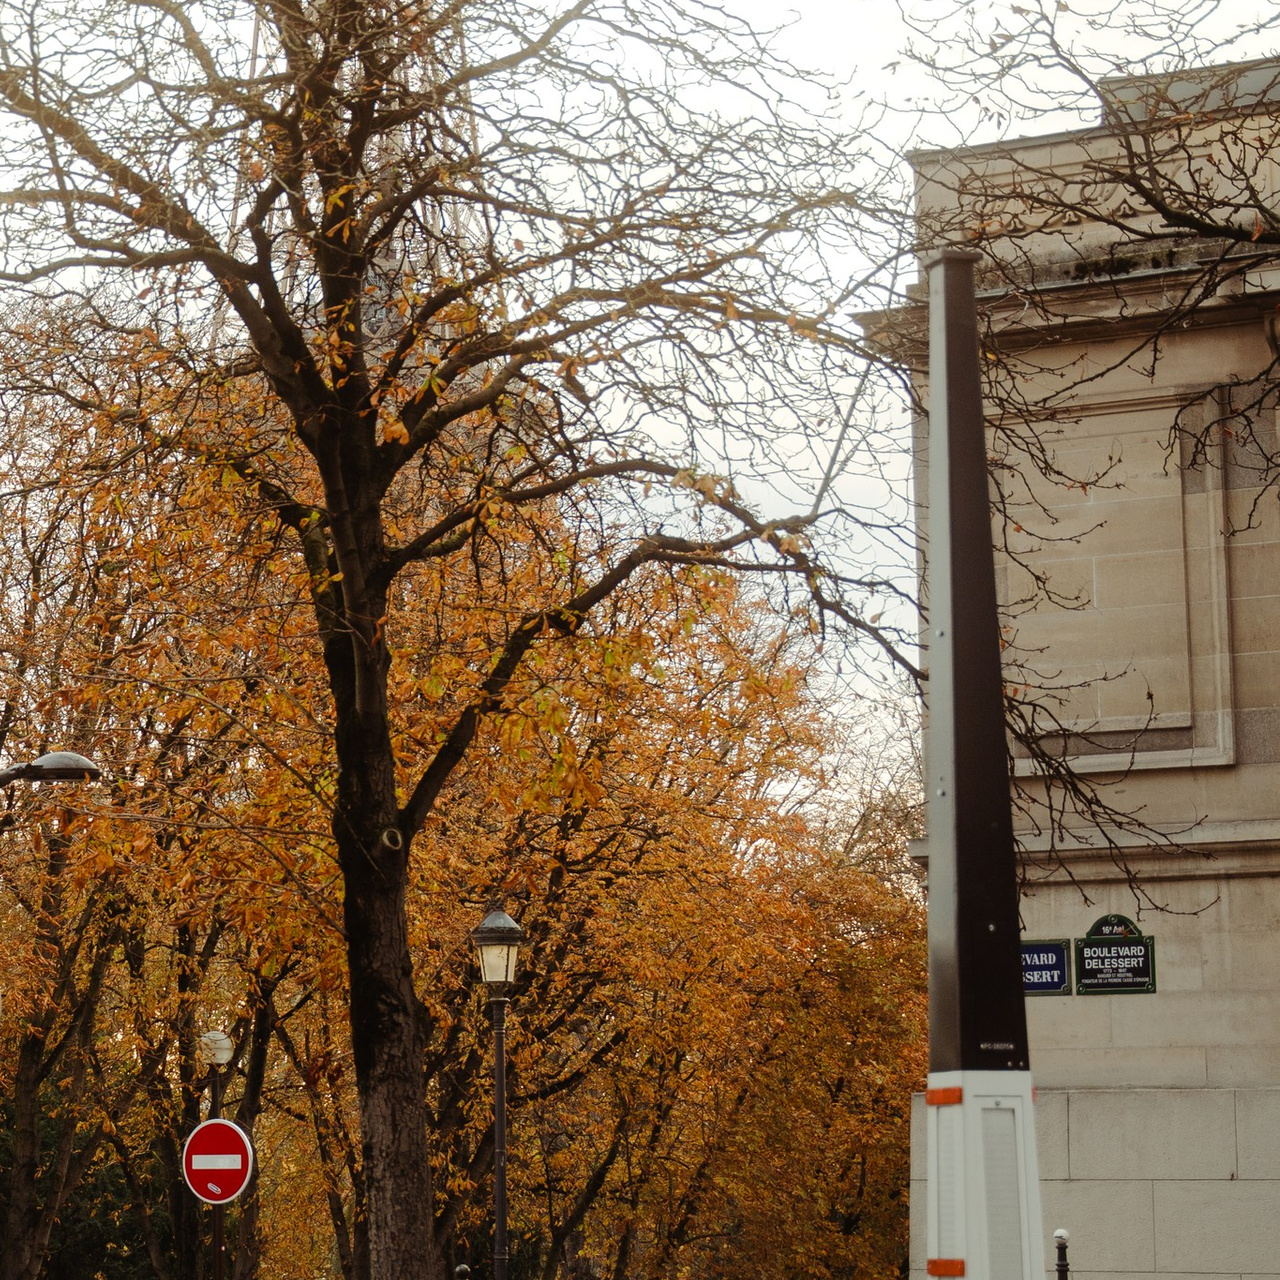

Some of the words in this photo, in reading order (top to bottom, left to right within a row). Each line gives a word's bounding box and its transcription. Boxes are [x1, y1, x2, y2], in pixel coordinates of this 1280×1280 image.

[1084, 946, 1144, 957] BOULEVARD
[1085, 958, 1144, 968] DELESSERT
[1022, 970, 1060, 983] SERT
